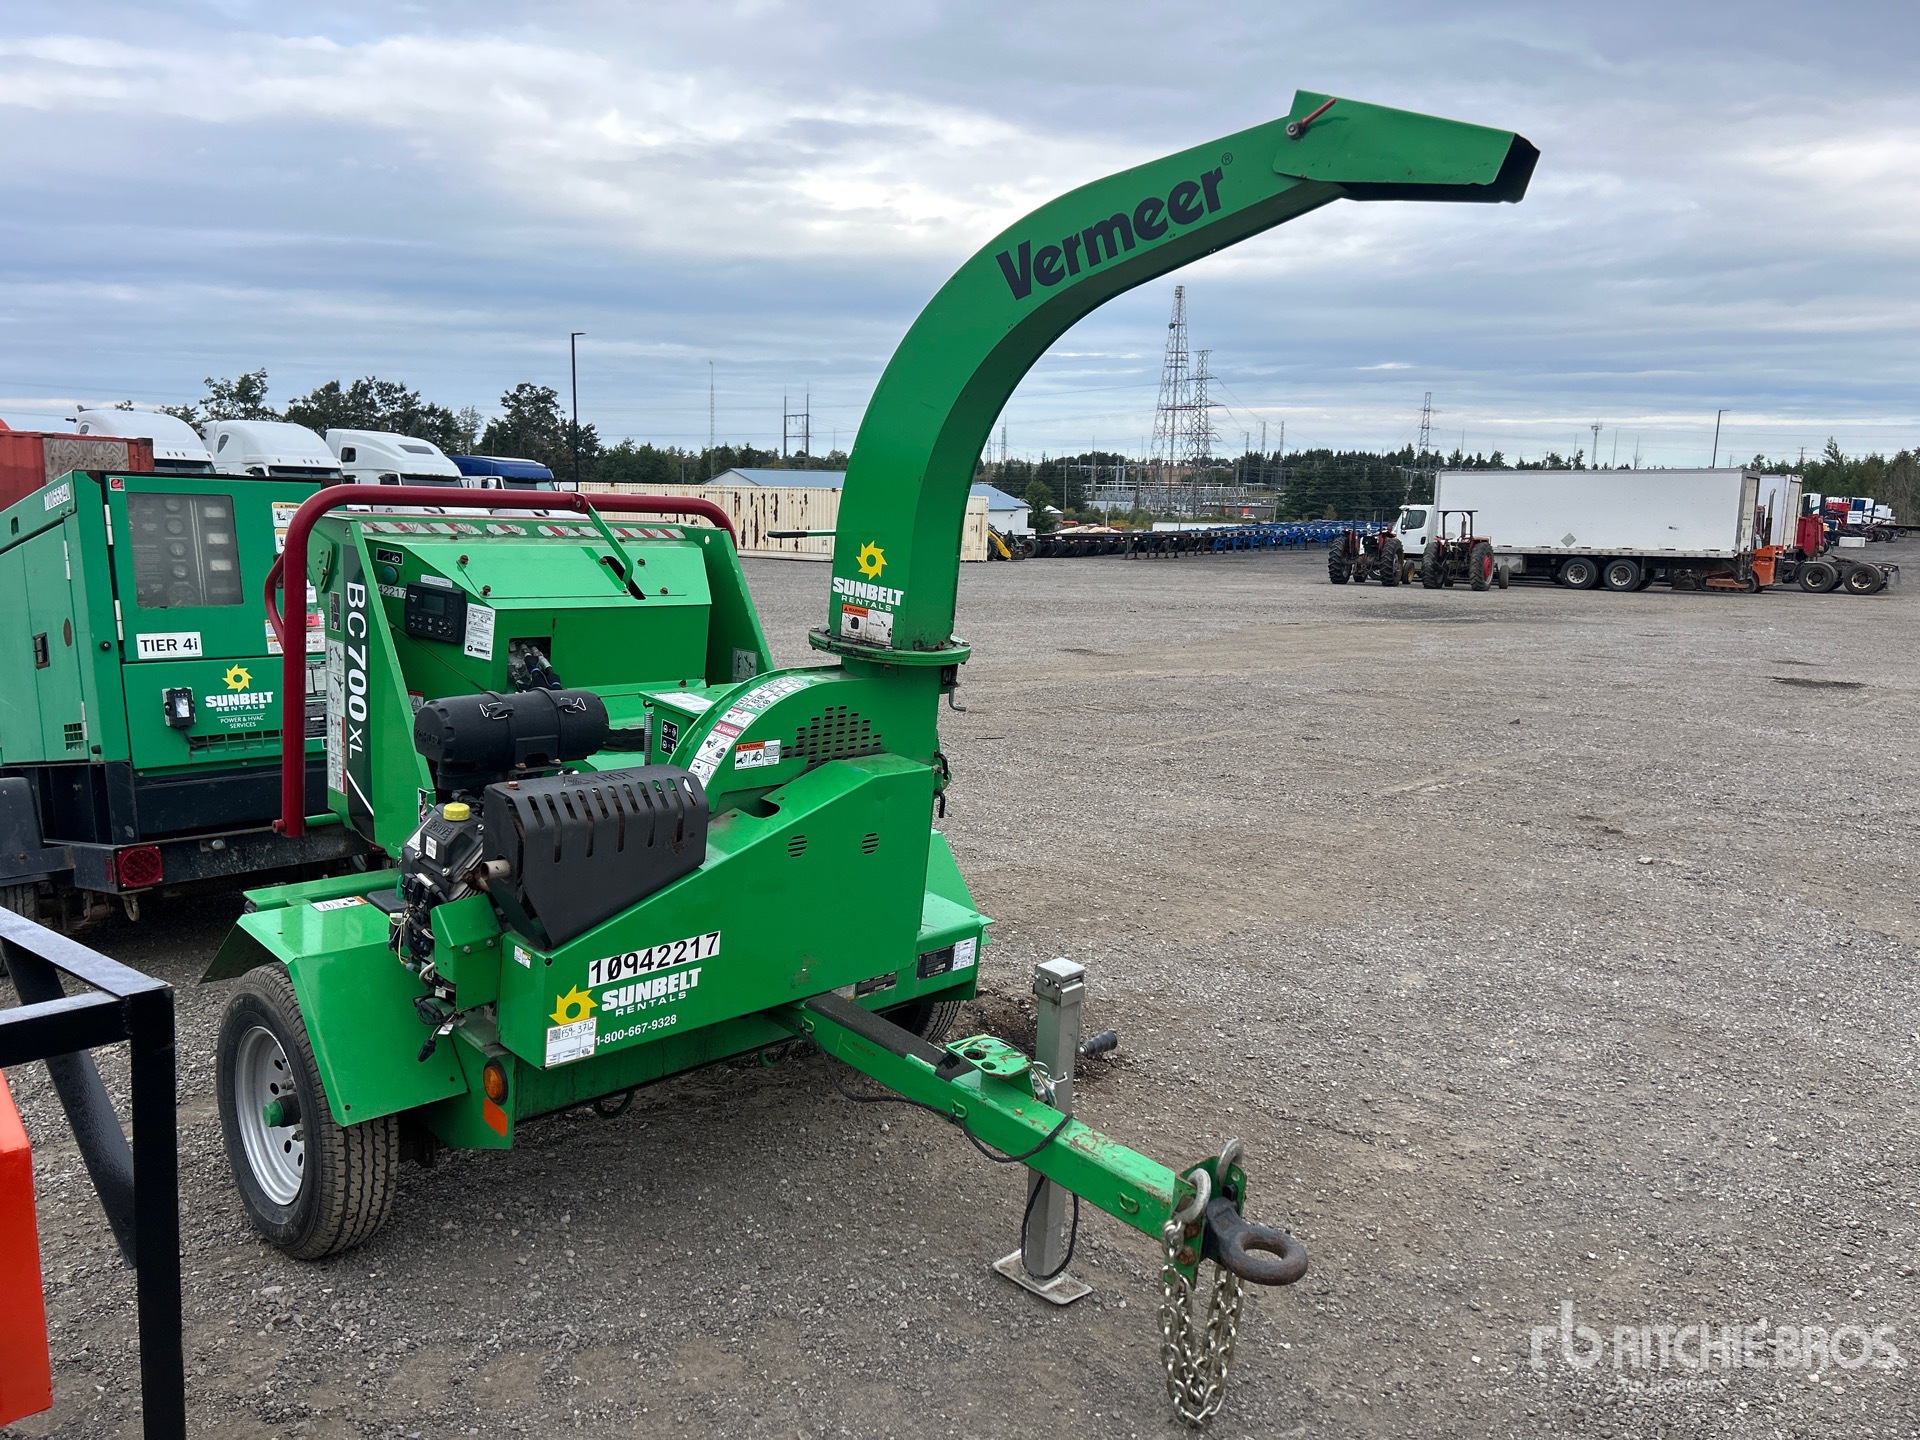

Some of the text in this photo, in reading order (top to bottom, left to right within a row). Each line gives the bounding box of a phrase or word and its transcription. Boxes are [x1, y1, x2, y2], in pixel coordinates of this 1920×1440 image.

[832, 576, 904, 606] SUNBELT
[841, 595, 891, 611] RENTALS
[140, 638, 198, 652] TIER 4i
[205, 691, 274, 708] SUNBELT
[216, 703, 265, 712] RENTALS
[220, 716, 242, 724] POWER
[247, 714, 264, 722] HVAC
[229, 721, 257, 729] SERVICES
[741, 742, 765, 750] WARNING
[596, 771, 634, 783] HOT
[590, 932, 719, 983] 10942217
[601, 968, 702, 1011] SUNBELT
[615, 991, 687, 1017] RENTALS
[595, 1014, 677, 1047] 1-800-667-9328
